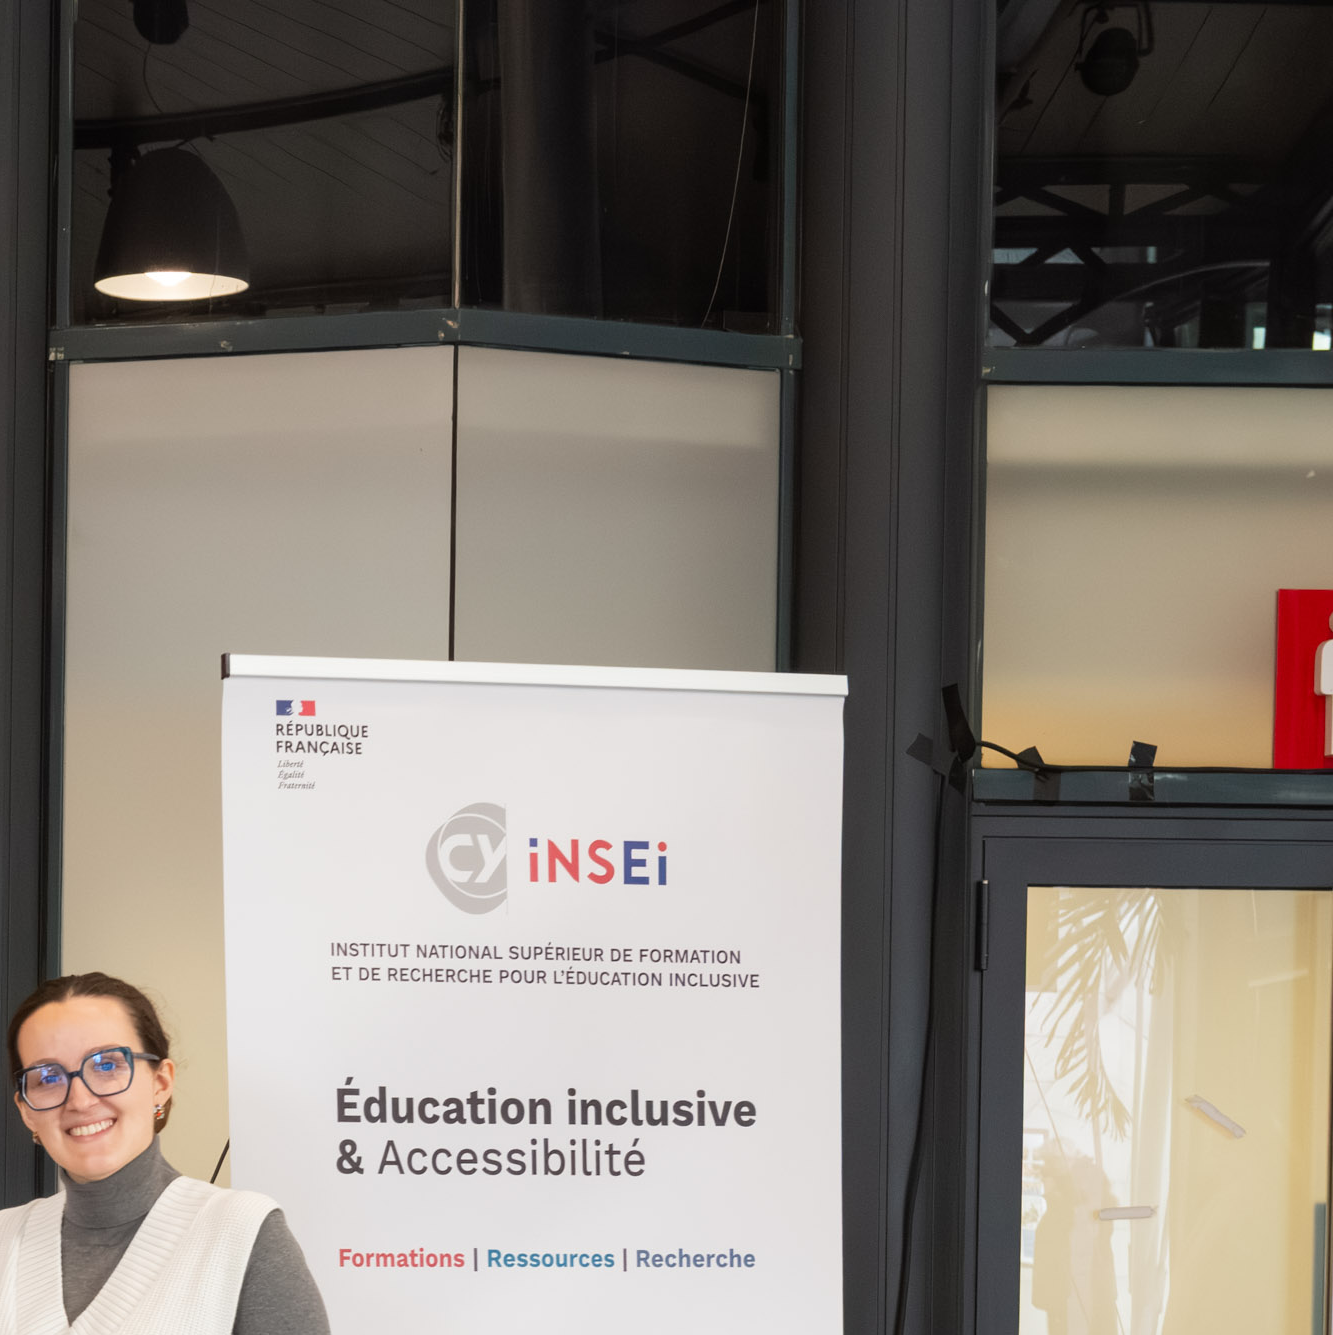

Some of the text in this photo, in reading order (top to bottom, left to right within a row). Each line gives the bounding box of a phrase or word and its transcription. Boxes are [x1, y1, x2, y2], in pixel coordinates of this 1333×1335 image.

[276, 720, 369, 740] RÉPUBLIQUE
[276, 741, 362, 756] FRANÇAISE
[277, 760, 304, 768] Liberté
[278, 770, 304, 780] Égalité
[278, 781, 315, 790] Fraternité
[331, 941, 741, 965] INSTITUT NATIONAL SUPÉRIEUR DE FORMATION
[331, 966, 760, 988] ET DE RECHERCHE POUR L'ÉDUCATION INCLUSIVE
[336, 1076, 757, 1128] Éducation inclusive
[336, 1138, 645, 1177] & Accessibilité
[338, 1247, 756, 1268] Formations Ressources Recherche
